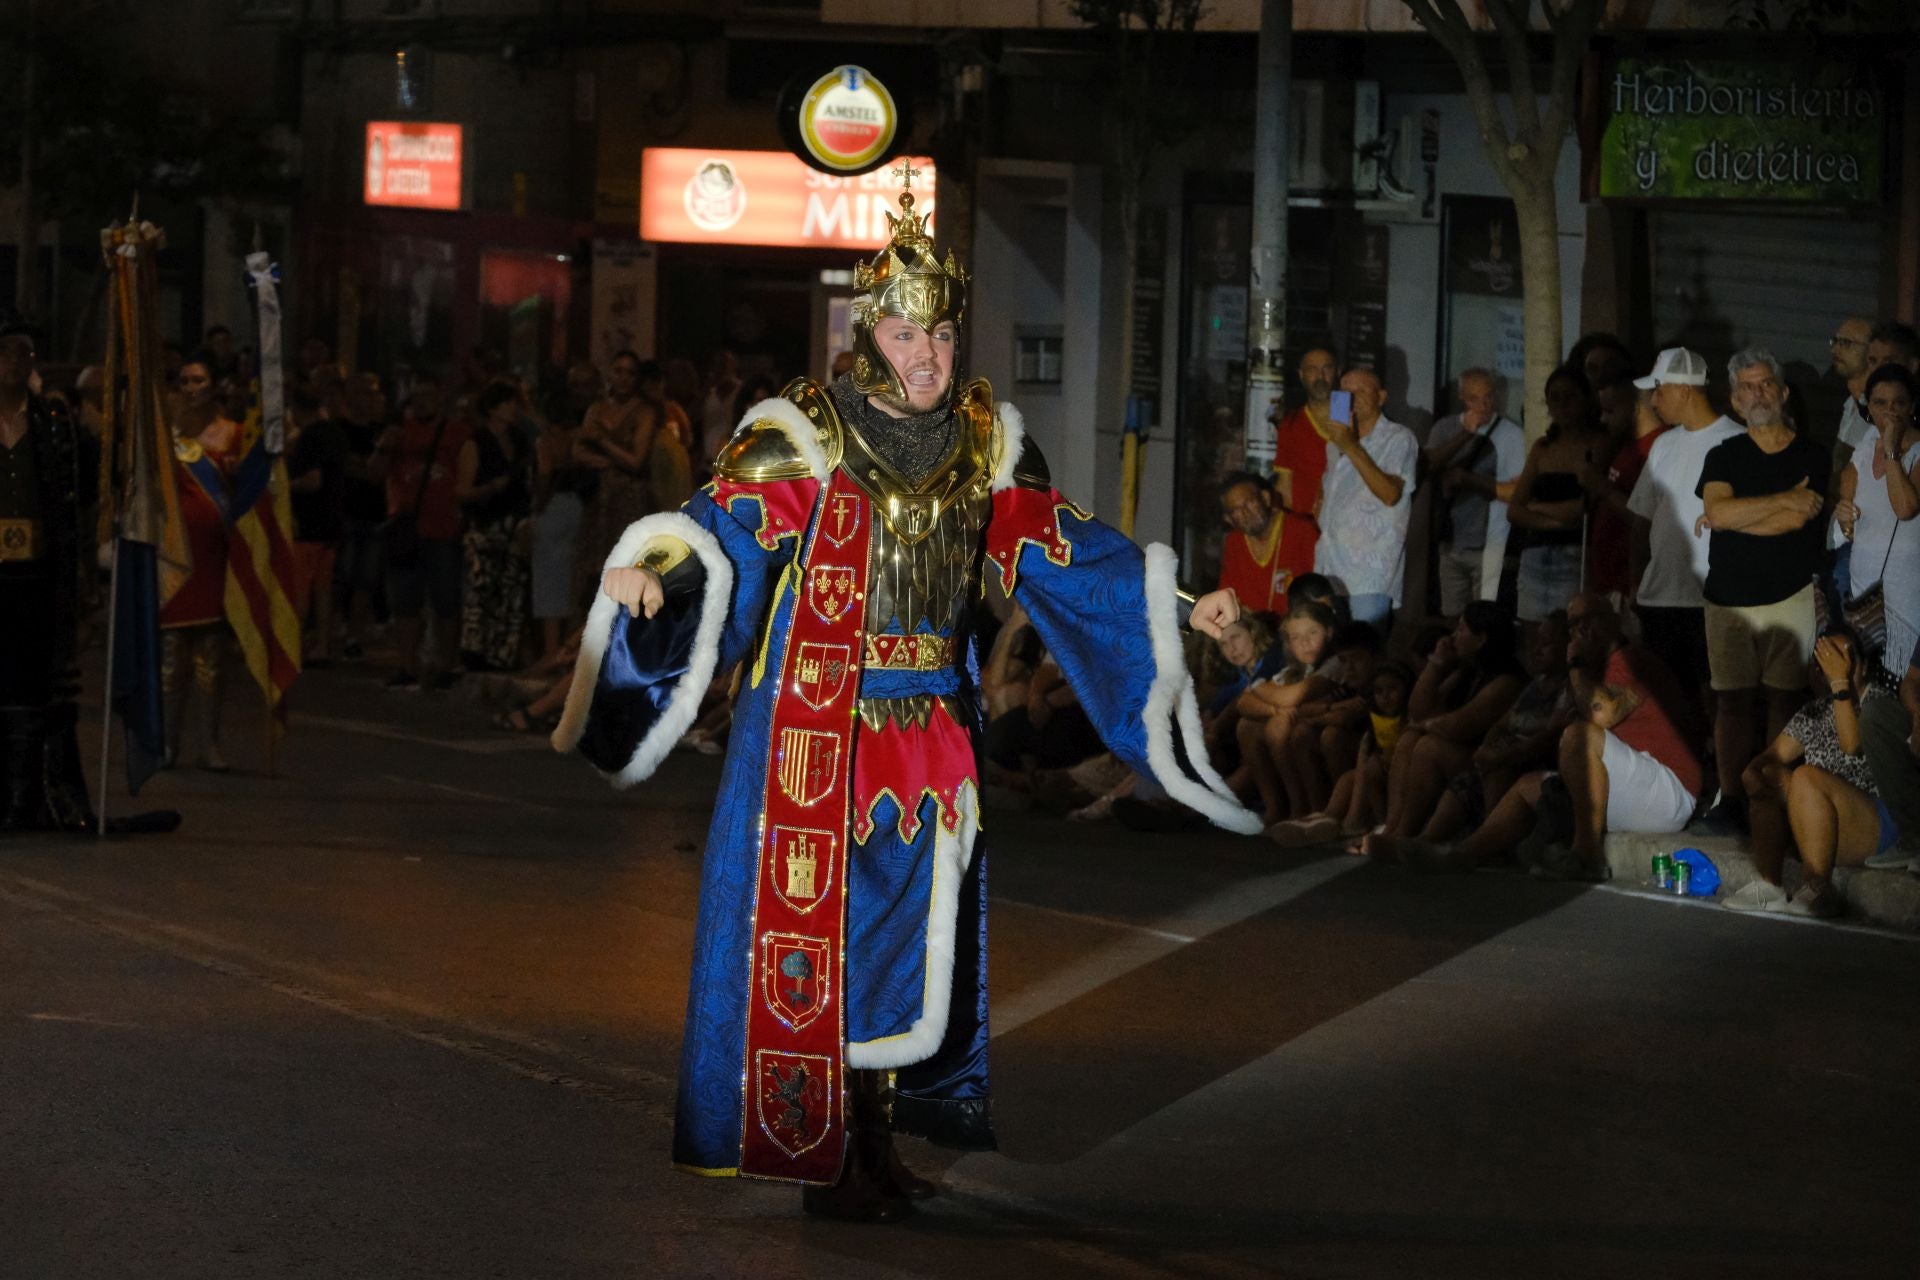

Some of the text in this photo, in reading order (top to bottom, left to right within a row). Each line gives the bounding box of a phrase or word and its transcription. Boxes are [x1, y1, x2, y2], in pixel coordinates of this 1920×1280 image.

[825, 105, 877, 121] AMSTEL
[1635, 138, 1860, 190] y dietética
